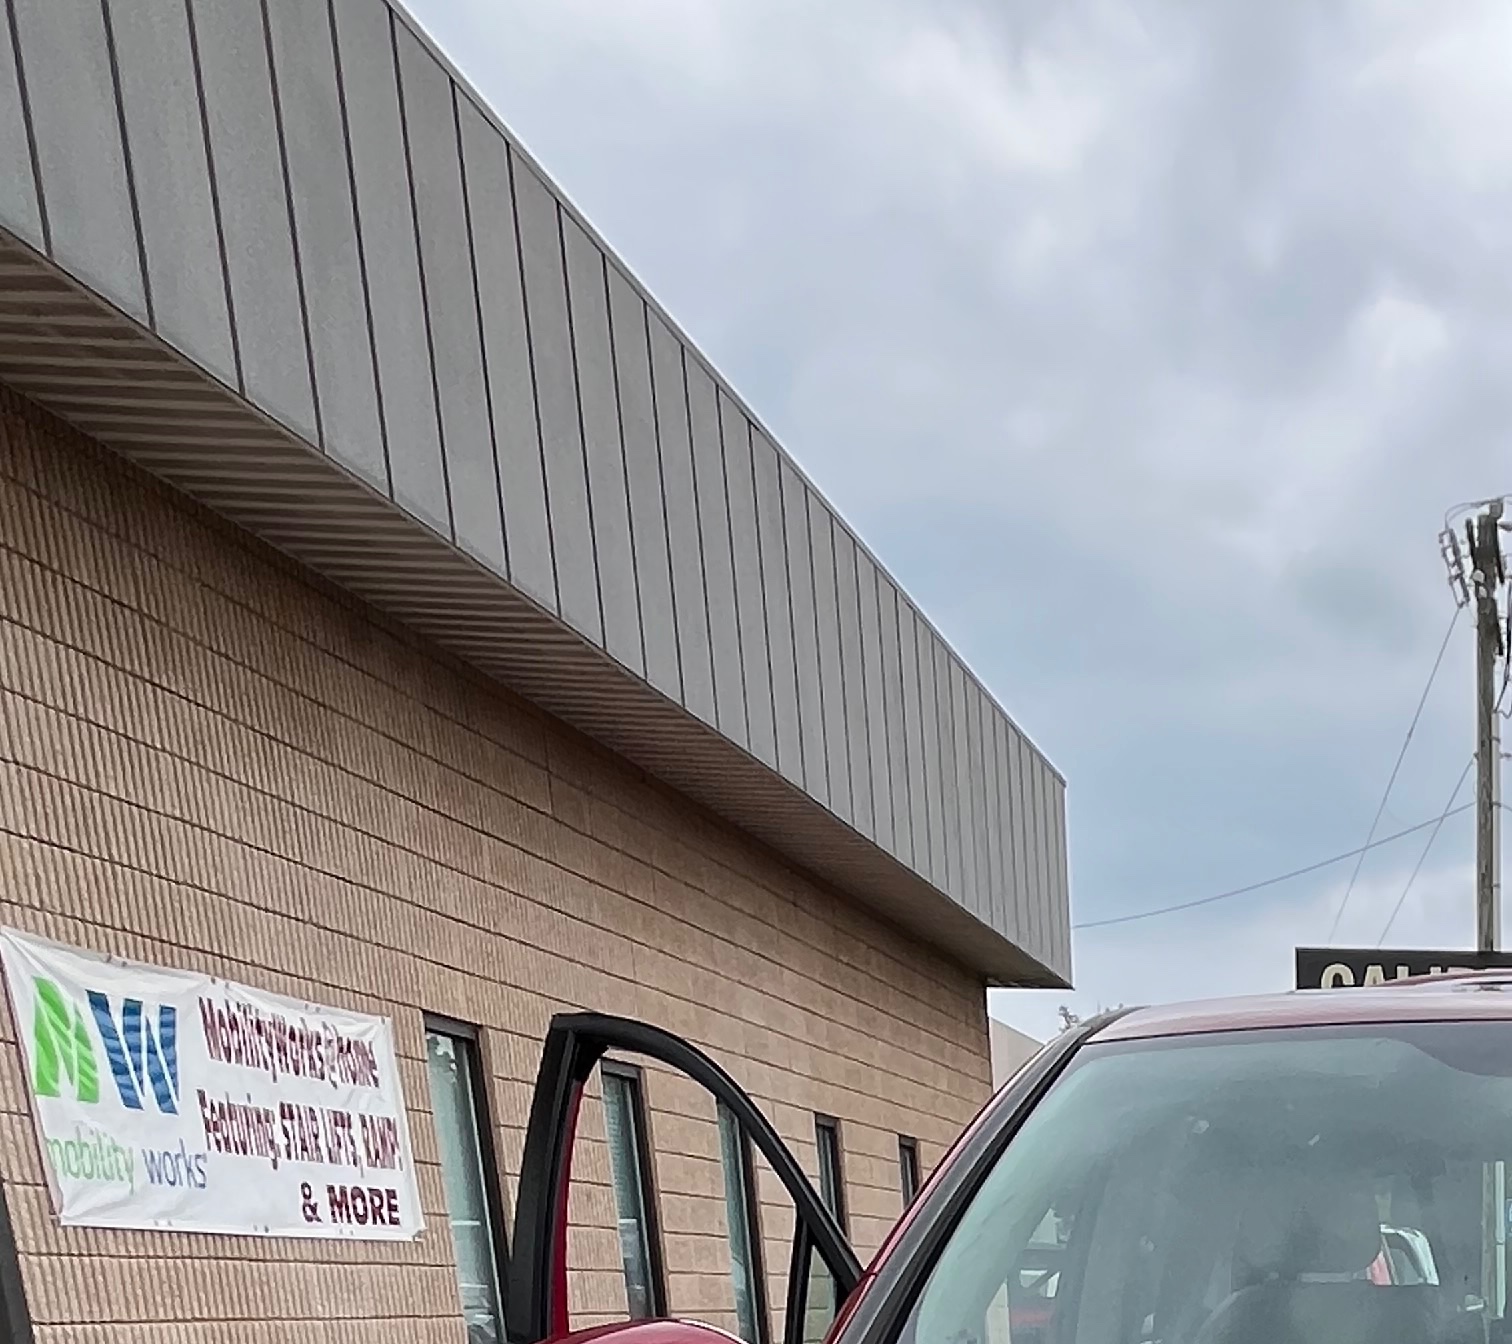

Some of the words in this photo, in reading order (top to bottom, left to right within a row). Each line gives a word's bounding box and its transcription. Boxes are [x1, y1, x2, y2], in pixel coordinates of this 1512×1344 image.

[279, 1101, 324, 1164] STAIR
[301, 1182, 322, 1223] &
[326, 1184, 401, 1226] MORE
